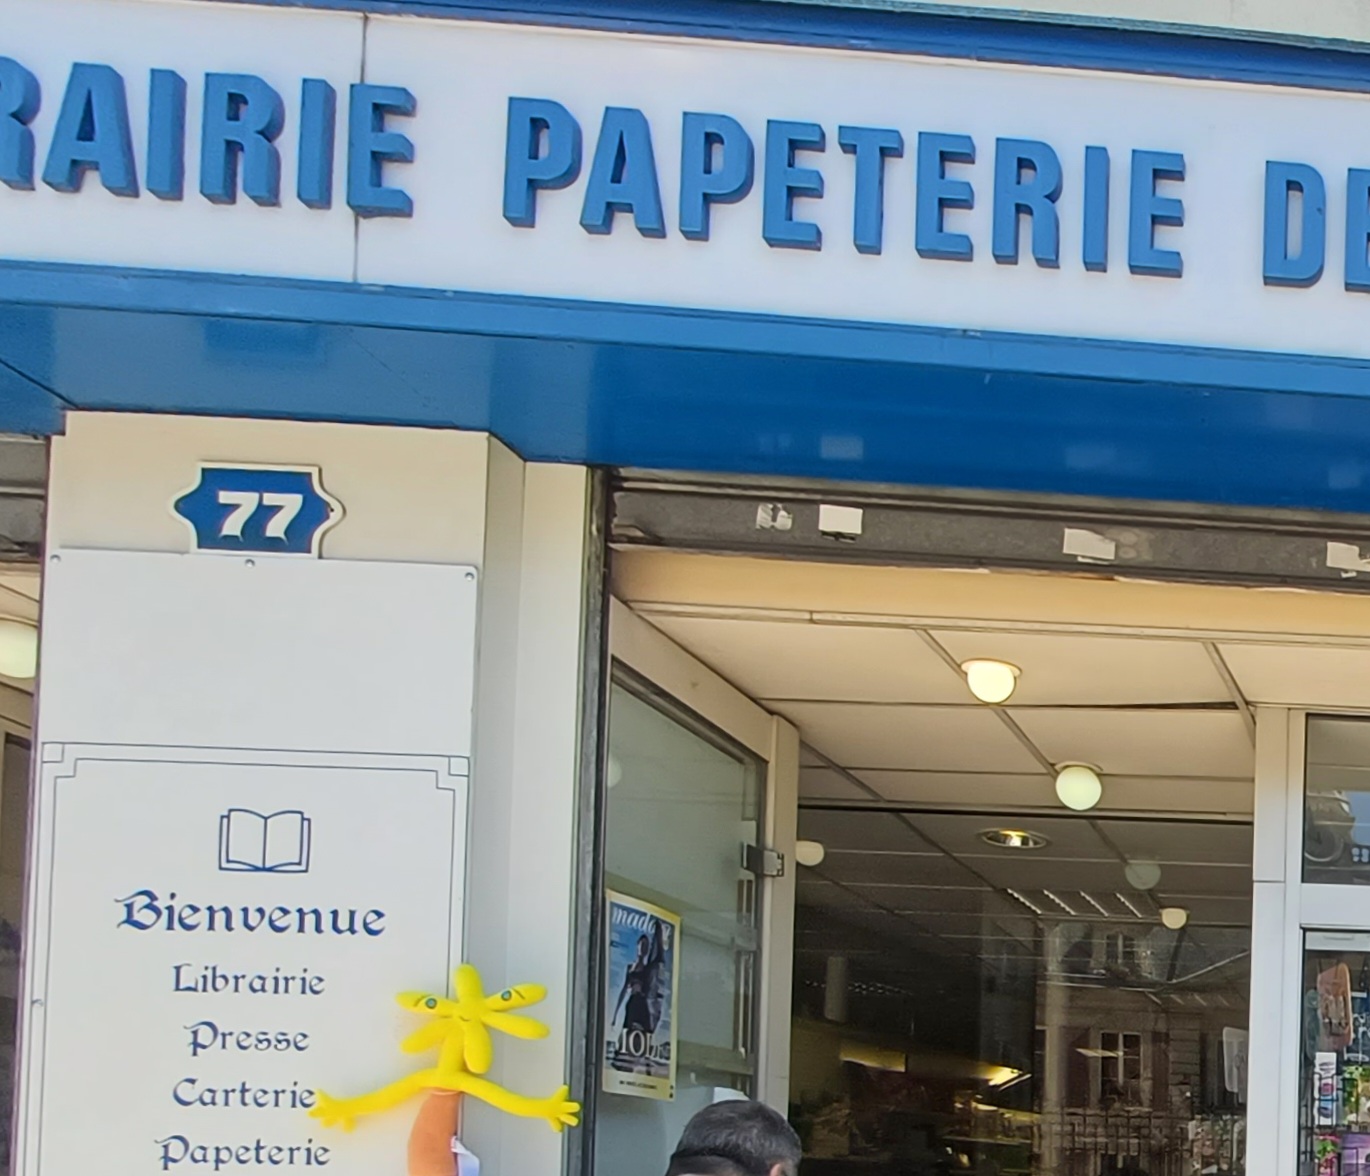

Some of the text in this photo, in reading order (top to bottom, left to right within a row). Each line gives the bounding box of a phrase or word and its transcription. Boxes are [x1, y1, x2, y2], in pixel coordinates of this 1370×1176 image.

[503, 96, 1186, 279] PAPETERIE
[217, 490, 304, 543] 77
[114, 889, 387, 937] Bienvenue
[610, 904, 671, 942] mada
[173, 963, 326, 996] Librairie
[184, 1021, 310, 1056] Presse
[172, 1077, 316, 1109] Carterie
[154, 1134, 331, 1171] Papeterie
